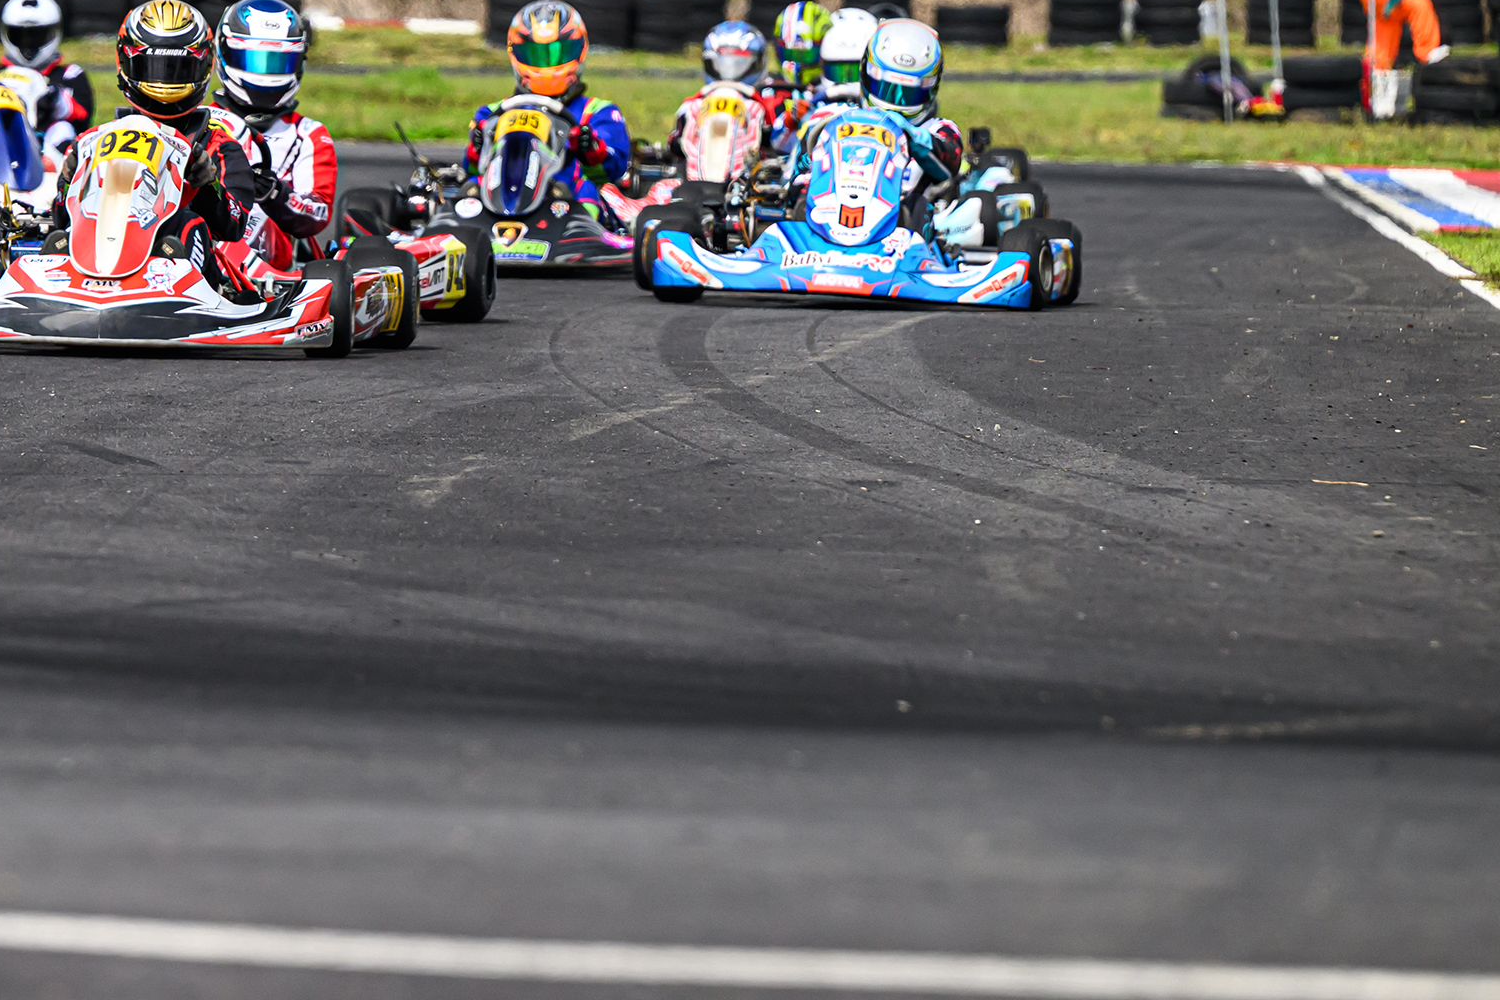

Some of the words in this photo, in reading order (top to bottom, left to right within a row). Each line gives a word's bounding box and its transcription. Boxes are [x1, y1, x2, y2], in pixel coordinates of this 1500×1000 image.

[508, 113, 540, 129] 995
[100, 130, 160, 161] 921
[839, 123, 895, 148] 926
